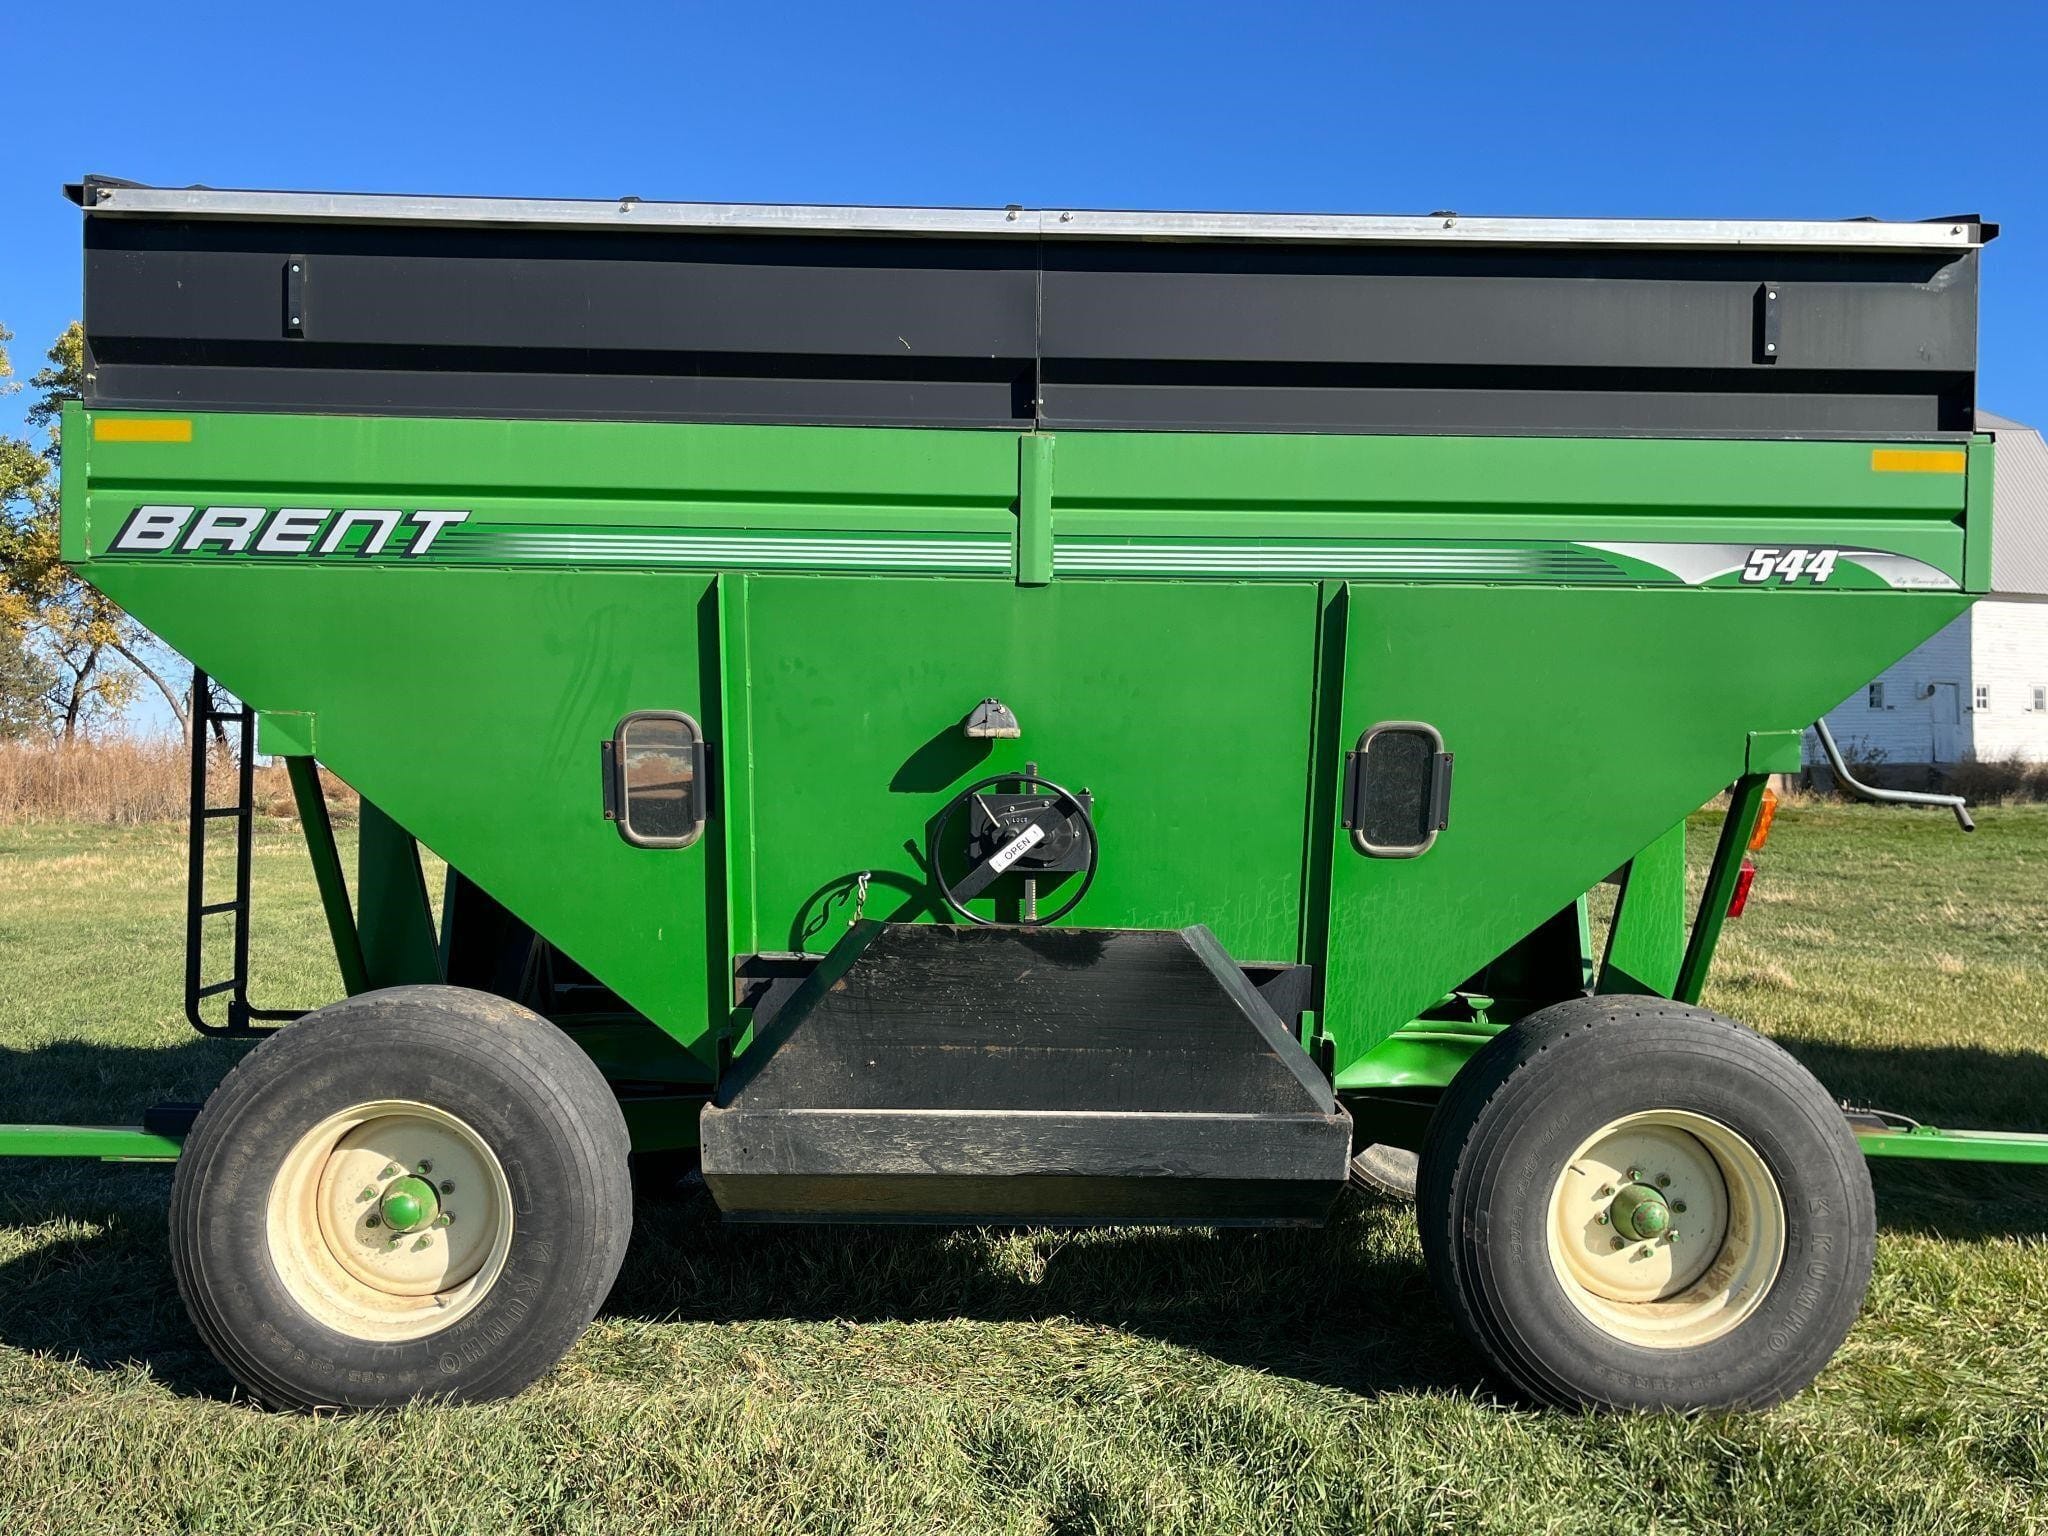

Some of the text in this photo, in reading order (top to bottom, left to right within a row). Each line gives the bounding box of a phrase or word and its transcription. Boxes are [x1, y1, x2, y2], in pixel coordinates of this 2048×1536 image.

[106, 505, 471, 558] BRENT
[1740, 548, 1839, 584] 544
[1004, 836, 1031, 860] OPEN
[1768, 1232, 1832, 1352] KUMHO
[439, 1273, 542, 1375] KUMHO
